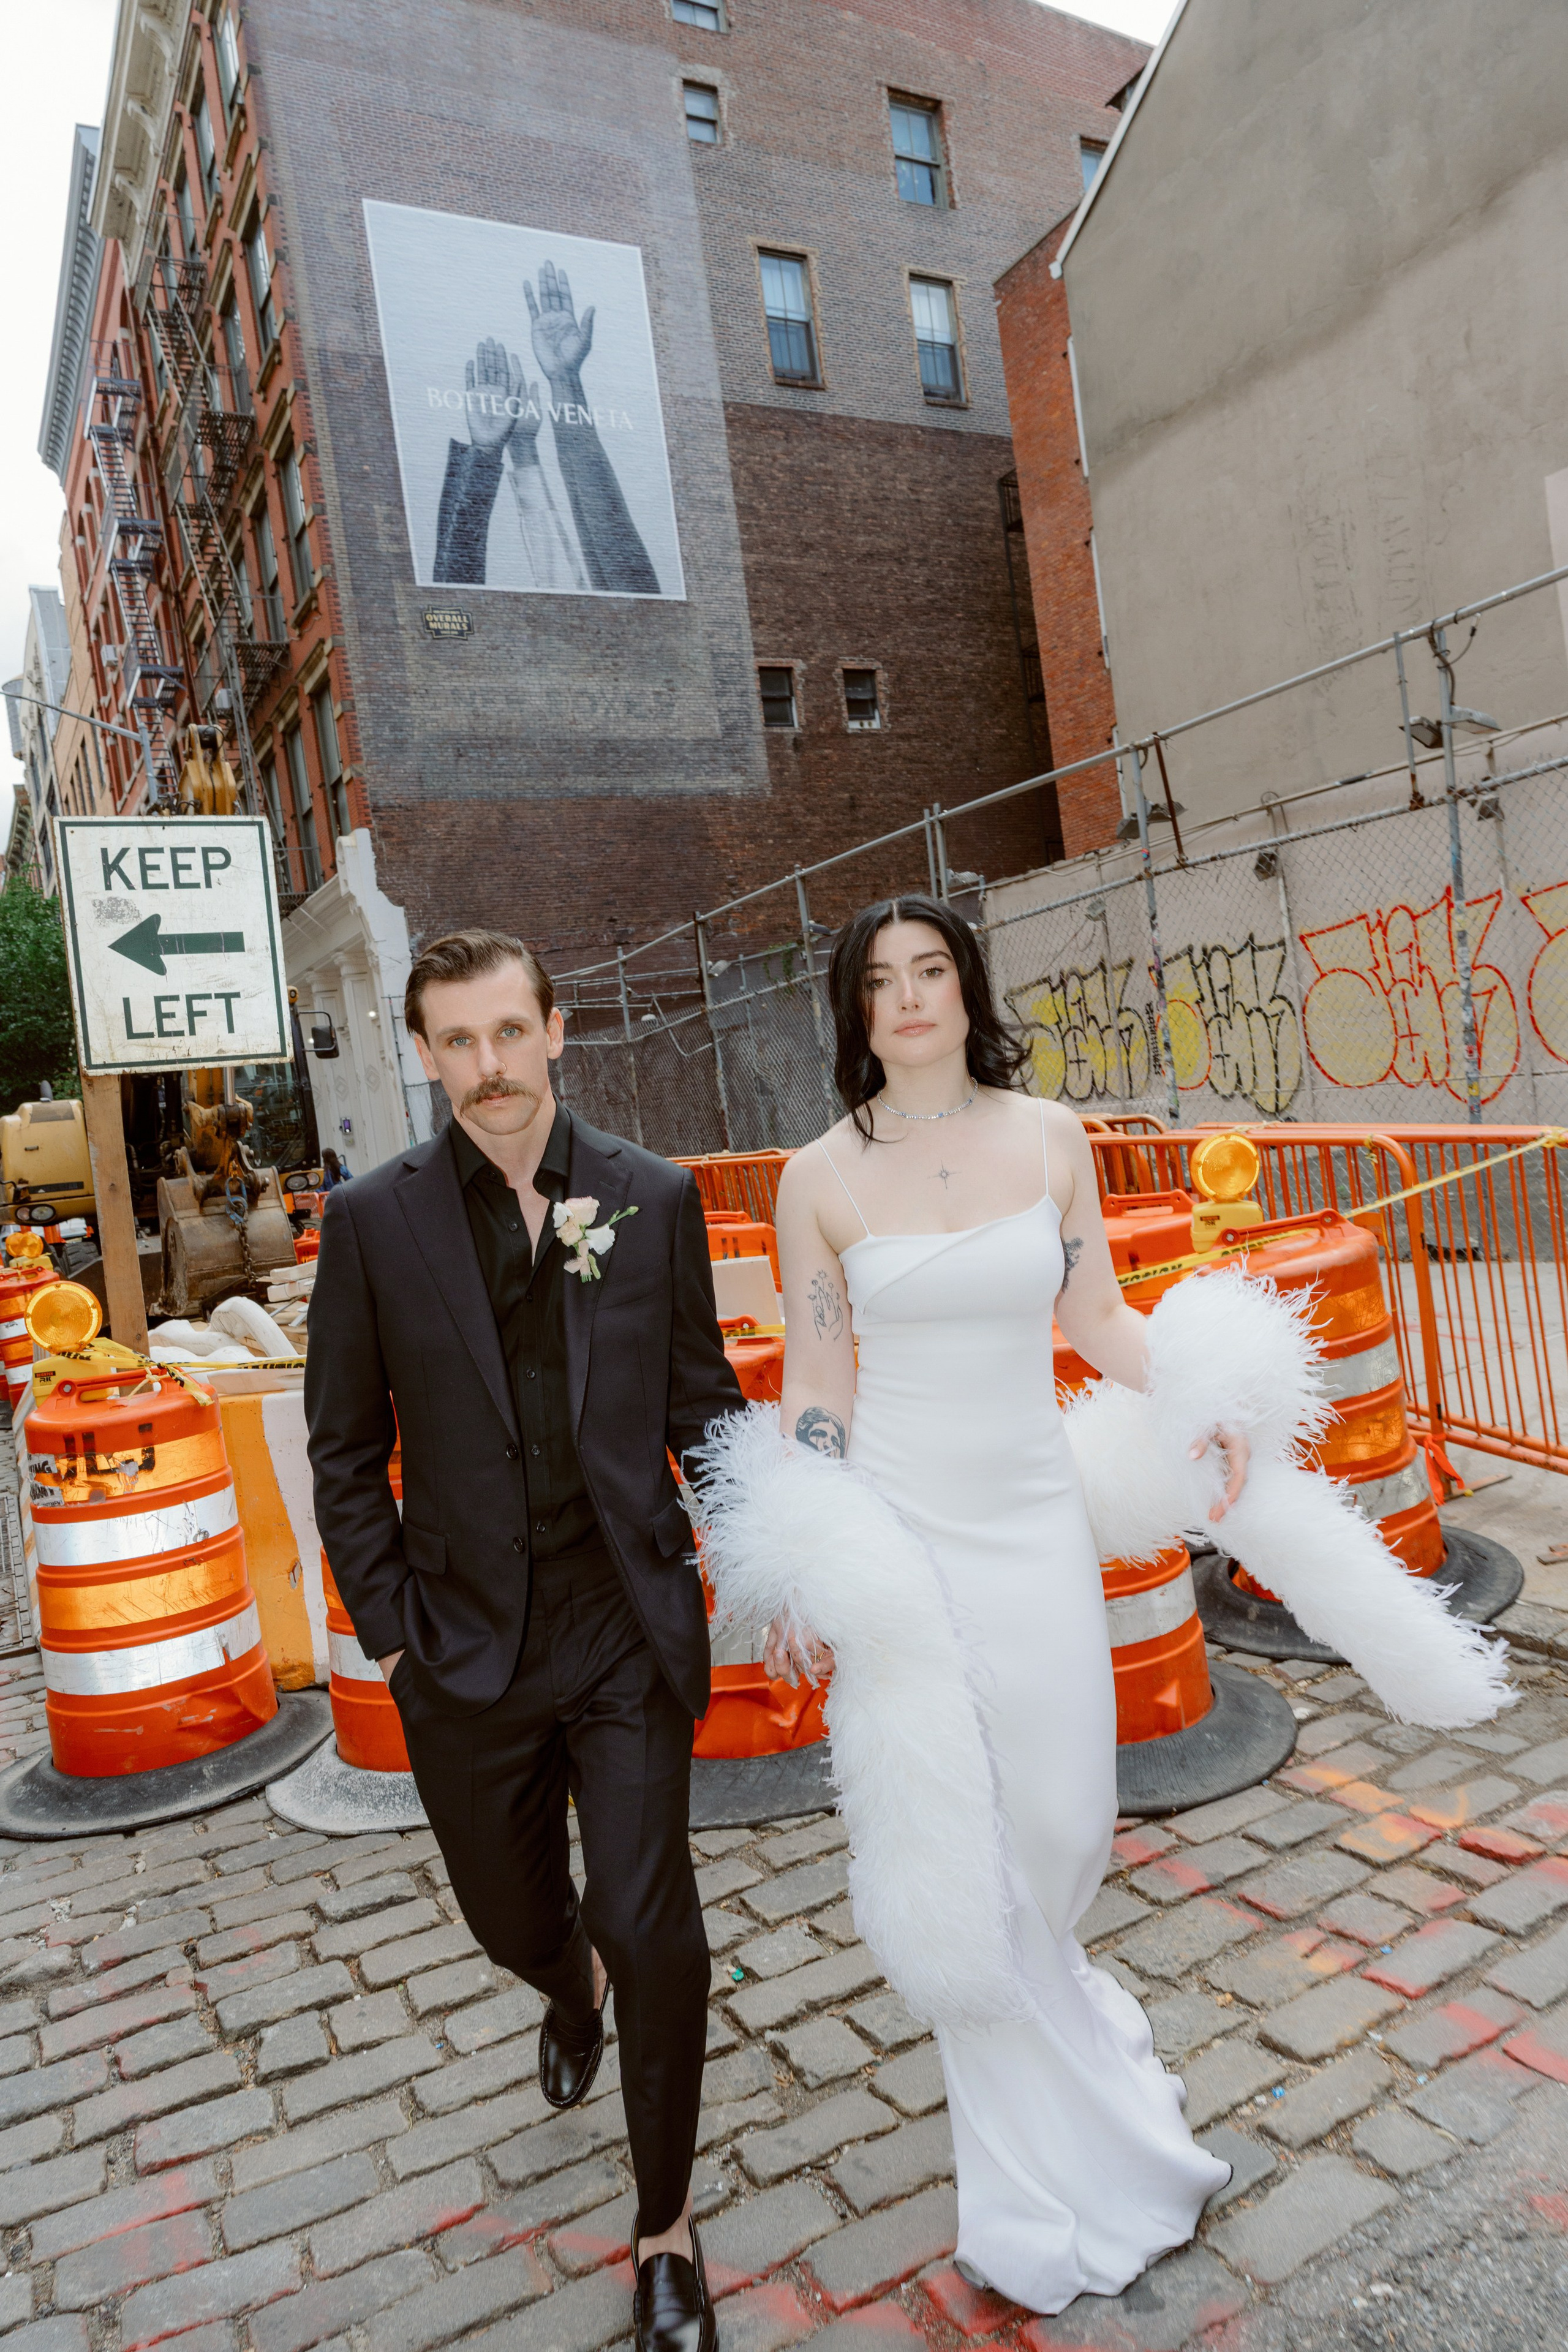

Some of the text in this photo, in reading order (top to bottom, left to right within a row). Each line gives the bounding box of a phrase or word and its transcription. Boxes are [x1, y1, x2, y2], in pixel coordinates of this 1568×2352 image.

[427, 387, 633, 430] BOTTEGA VENETA
[426, 614, 469, 623] OVERALL
[429, 622, 468, 630] MURALS
[100, 846, 232, 891] KEEP
[123, 992, 241, 1039] LEFT
